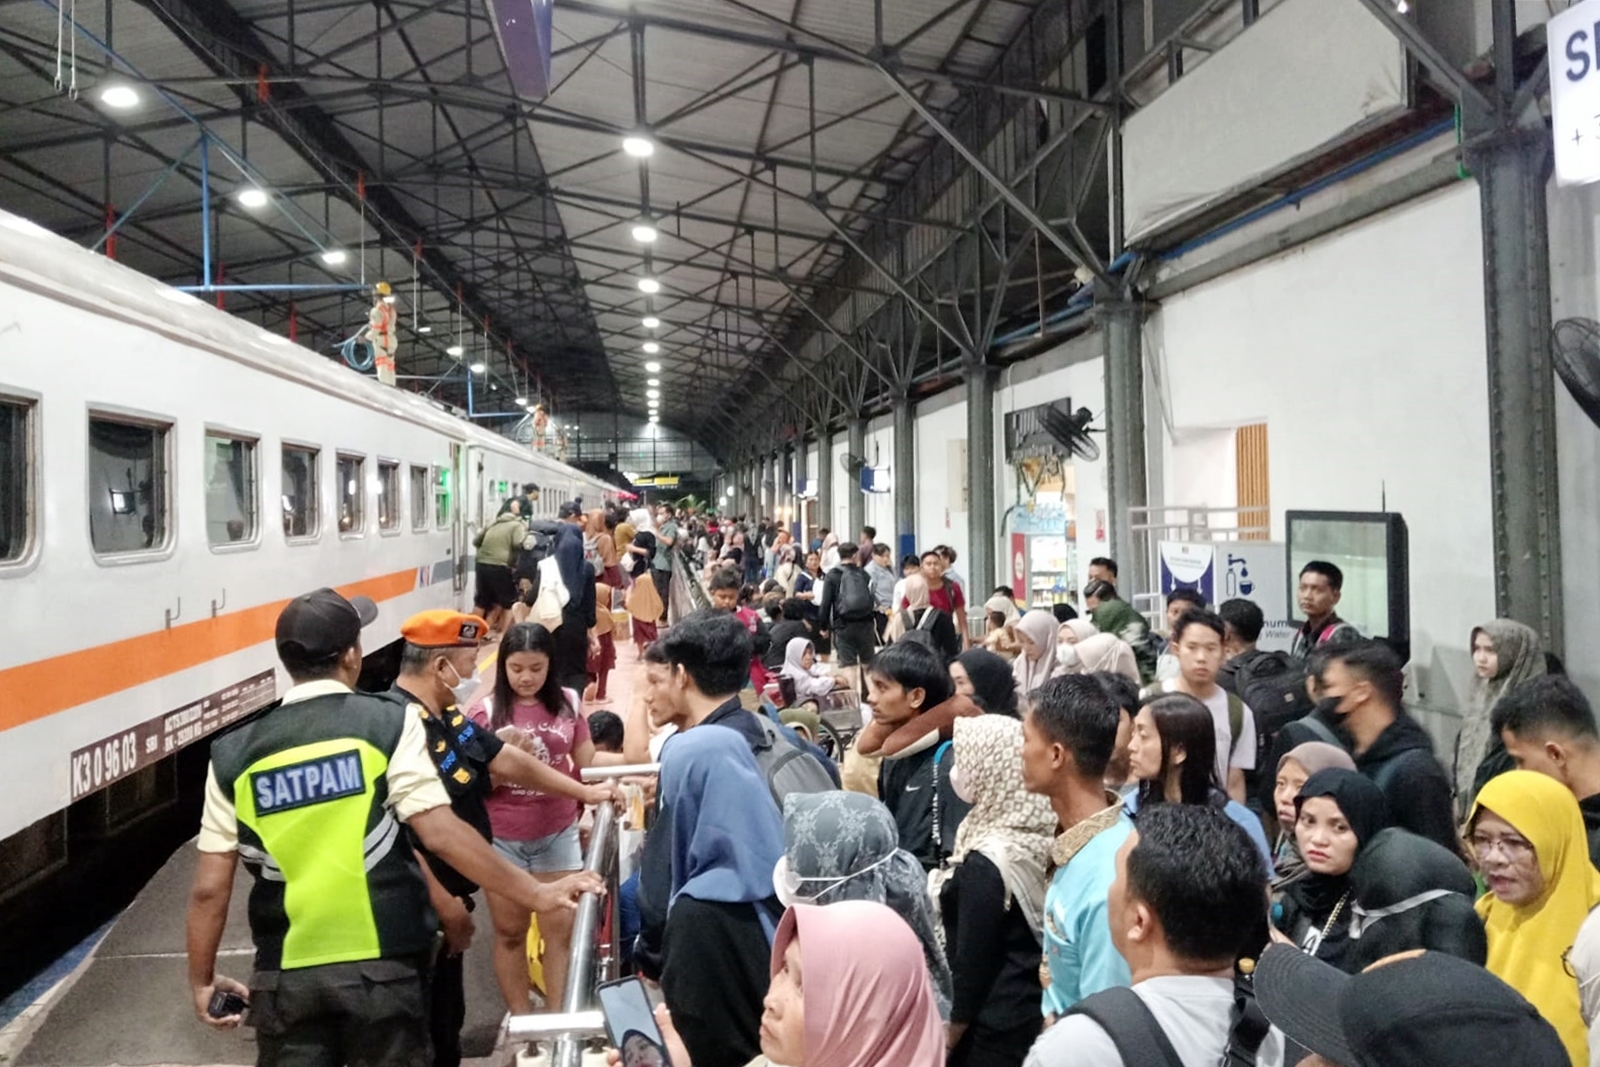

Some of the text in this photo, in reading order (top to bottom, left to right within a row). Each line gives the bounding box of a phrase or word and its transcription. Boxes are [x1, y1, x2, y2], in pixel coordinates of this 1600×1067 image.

[1565, 20, 1600, 81] S
[1263, 620, 1288, 628] num
[73, 751, 91, 798] K3
[94, 746, 102, 787] 0
[105, 738, 120, 781] 96
[122, 731, 137, 773] 03
[256, 756, 361, 809] SATPAM
